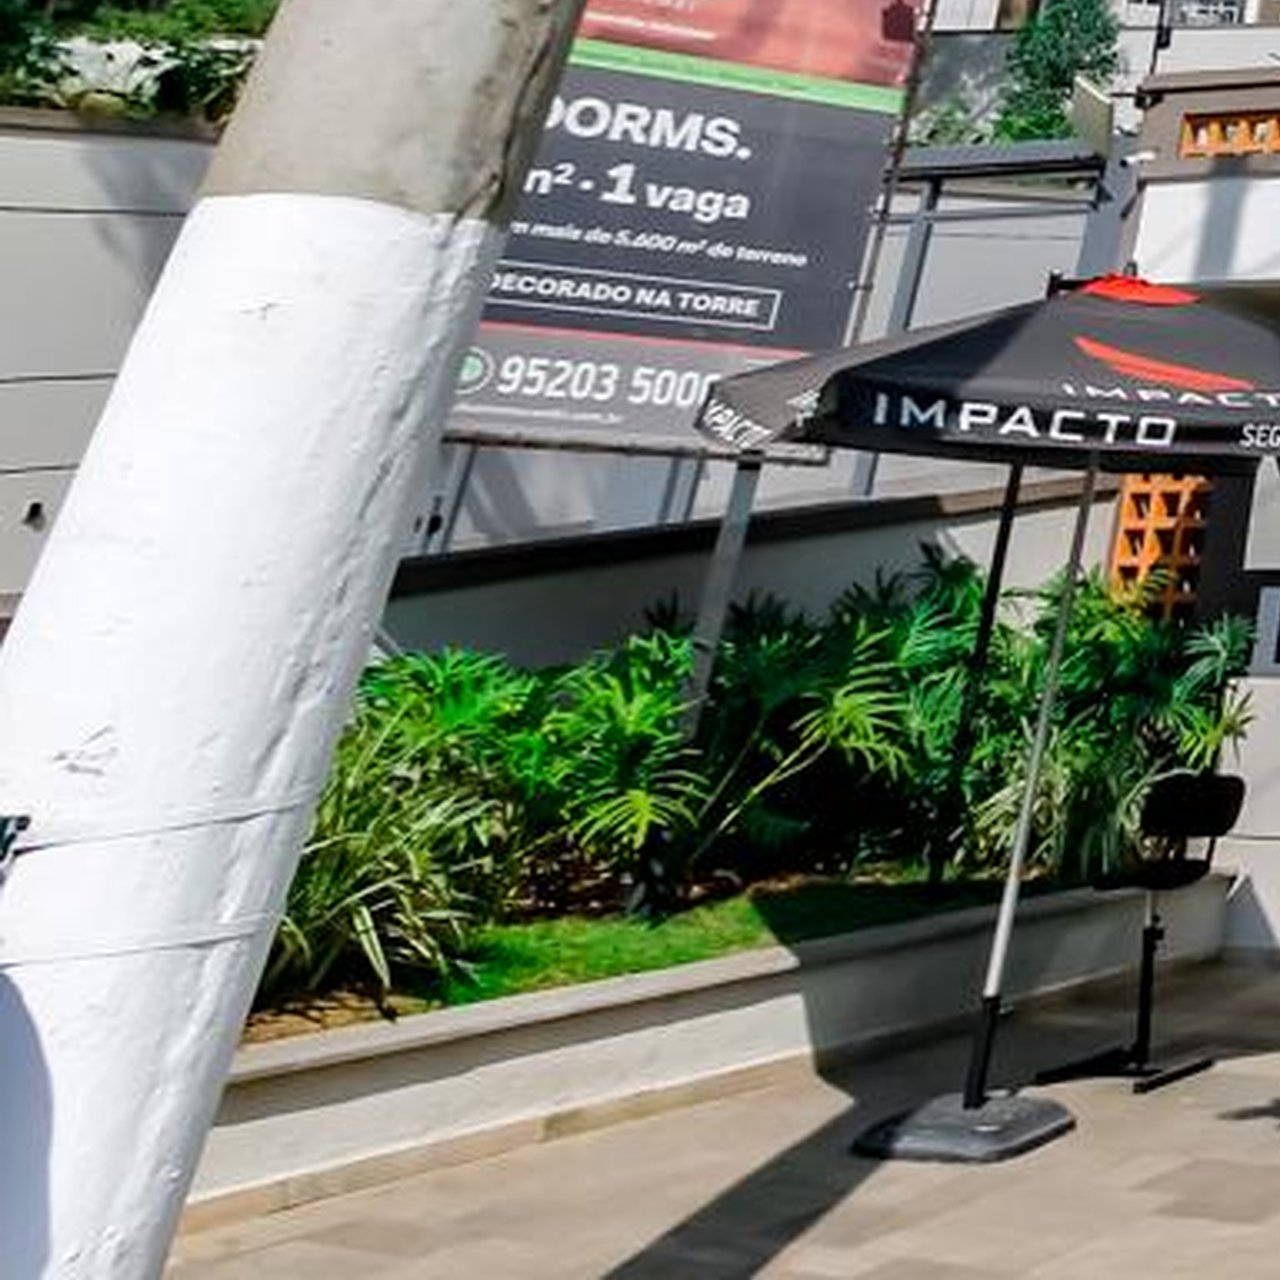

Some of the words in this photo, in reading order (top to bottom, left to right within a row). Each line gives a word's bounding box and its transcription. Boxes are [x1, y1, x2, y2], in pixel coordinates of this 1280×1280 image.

[600, 163, 637, 204] 1
[645, 182, 750, 222] vaga
[634, 288, 673, 308] NA
[677, 292, 761, 317] TORRE
[498, 355, 618, 401] 95203
[873, 392, 1177, 447] IMPACTO
